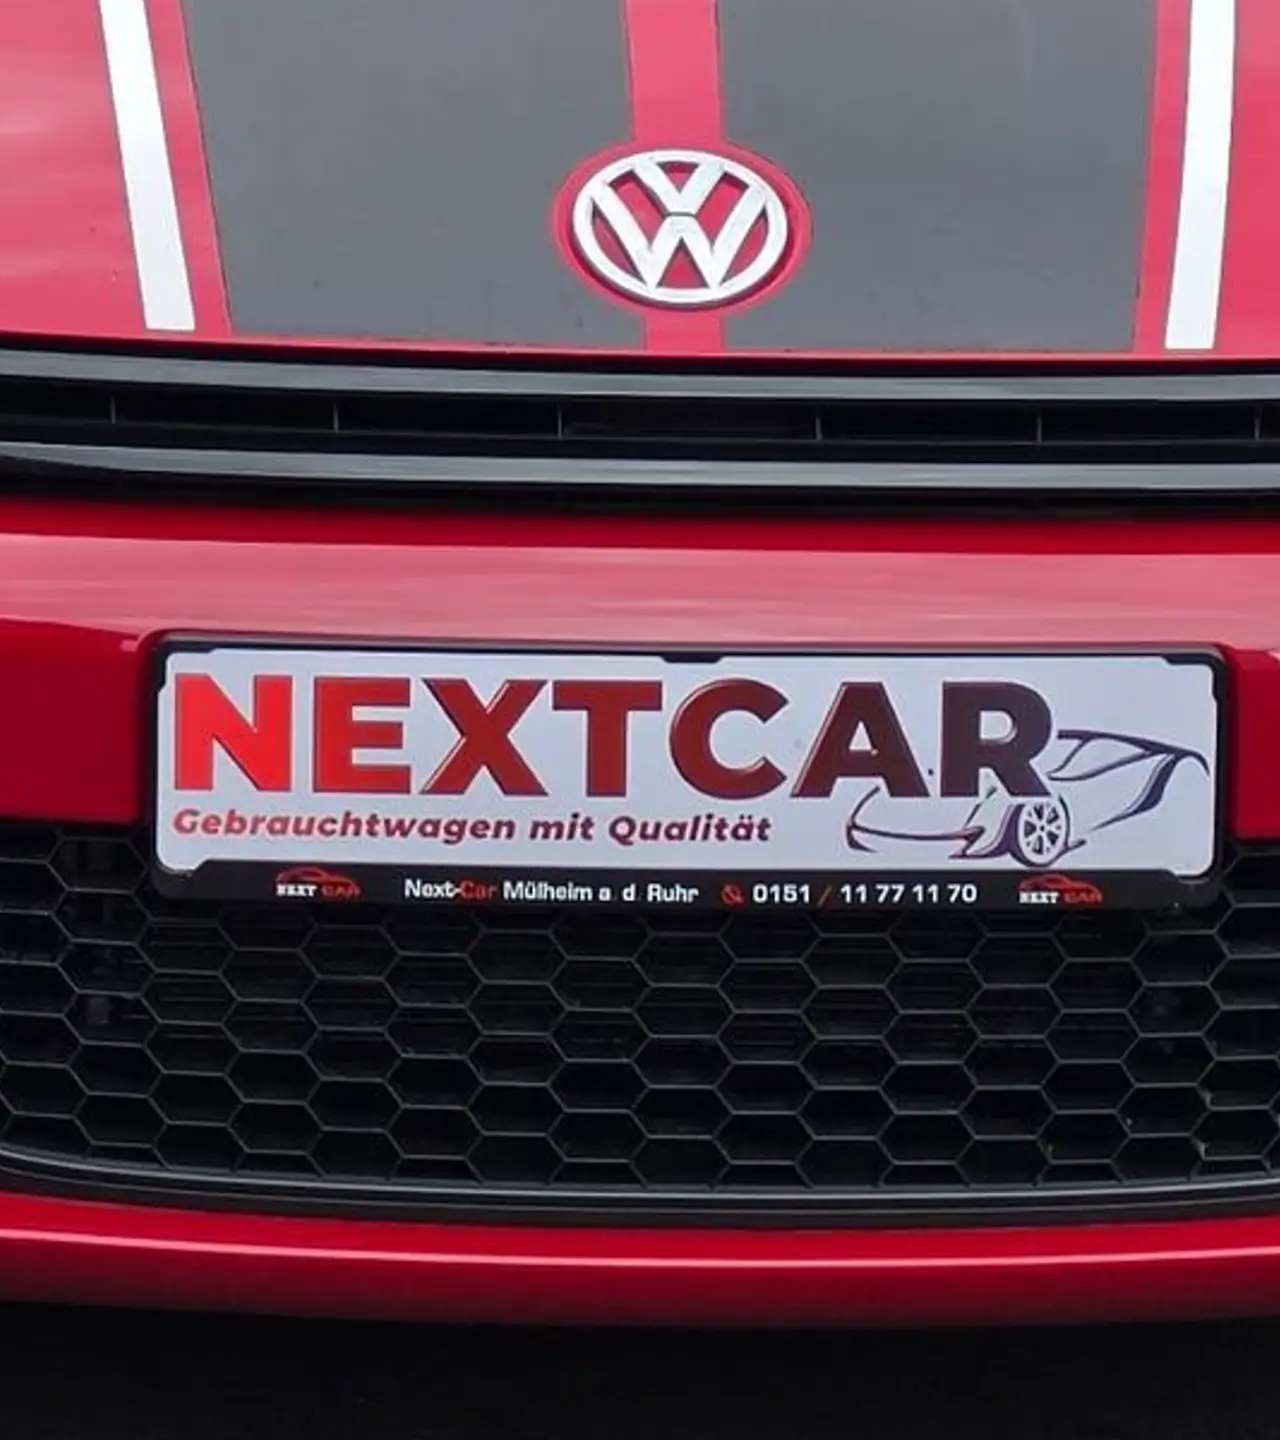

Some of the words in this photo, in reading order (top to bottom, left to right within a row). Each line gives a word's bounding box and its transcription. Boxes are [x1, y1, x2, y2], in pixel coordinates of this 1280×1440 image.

[174, 672, 1052, 801] NEXTCAR
[172, 809, 516, 846] Gebrauchtwagen
[528, 812, 595, 842] mit
[608, 812, 772, 847] Qualität
[502, 879, 594, 902] Mülheim
[646, 882, 700, 904] Ruhr
[752, 883, 811, 904] 0151
[840, 883, 868, 904] 11
[875, 883, 906, 904] 77
[912, 883, 940, 904] 11
[947, 883, 979, 904] 70
